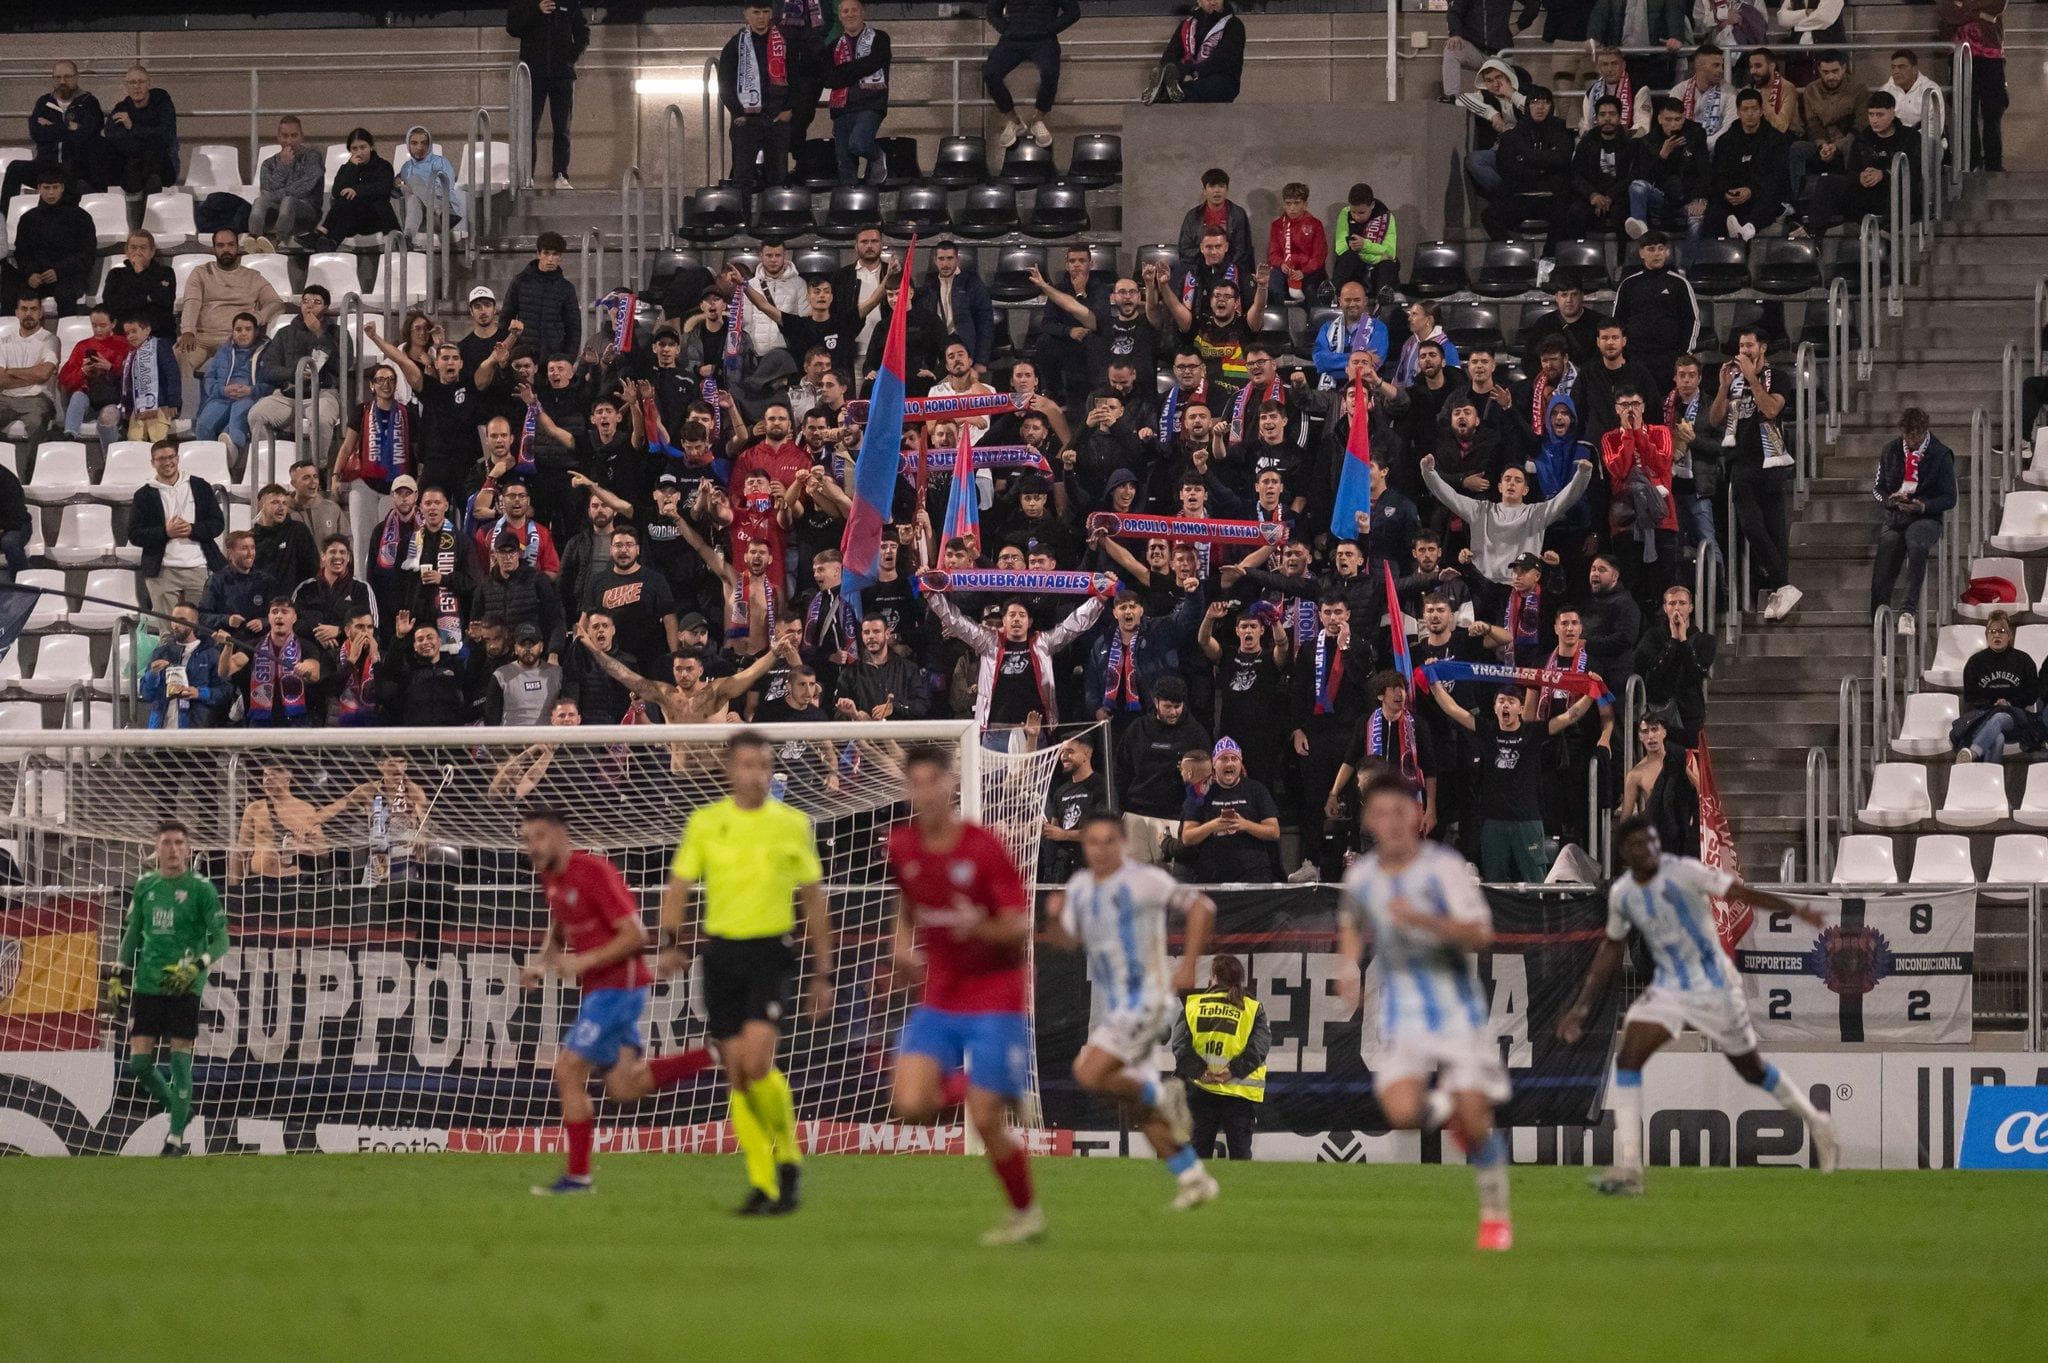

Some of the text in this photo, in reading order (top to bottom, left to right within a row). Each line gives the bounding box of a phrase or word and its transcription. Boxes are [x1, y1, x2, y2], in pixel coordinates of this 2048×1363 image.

[925, 399, 958, 413] HONOR
[960, 398, 967, 410] Y
[969, 394, 1009, 408] LEALTAD
[1124, 519, 1260, 538] ORGULLO, HONOR Y LEALTAD
[952, 573, 1090, 590] INQUEBRANTABLES
[602, 582, 644, 610] NIKE
[1744, 955, 1963, 972] SUPPORTERS INCONDICIONAL
[1199, 1004, 1242, 1019] Trablisa
[1769, 988, 1931, 1021] 2 2
